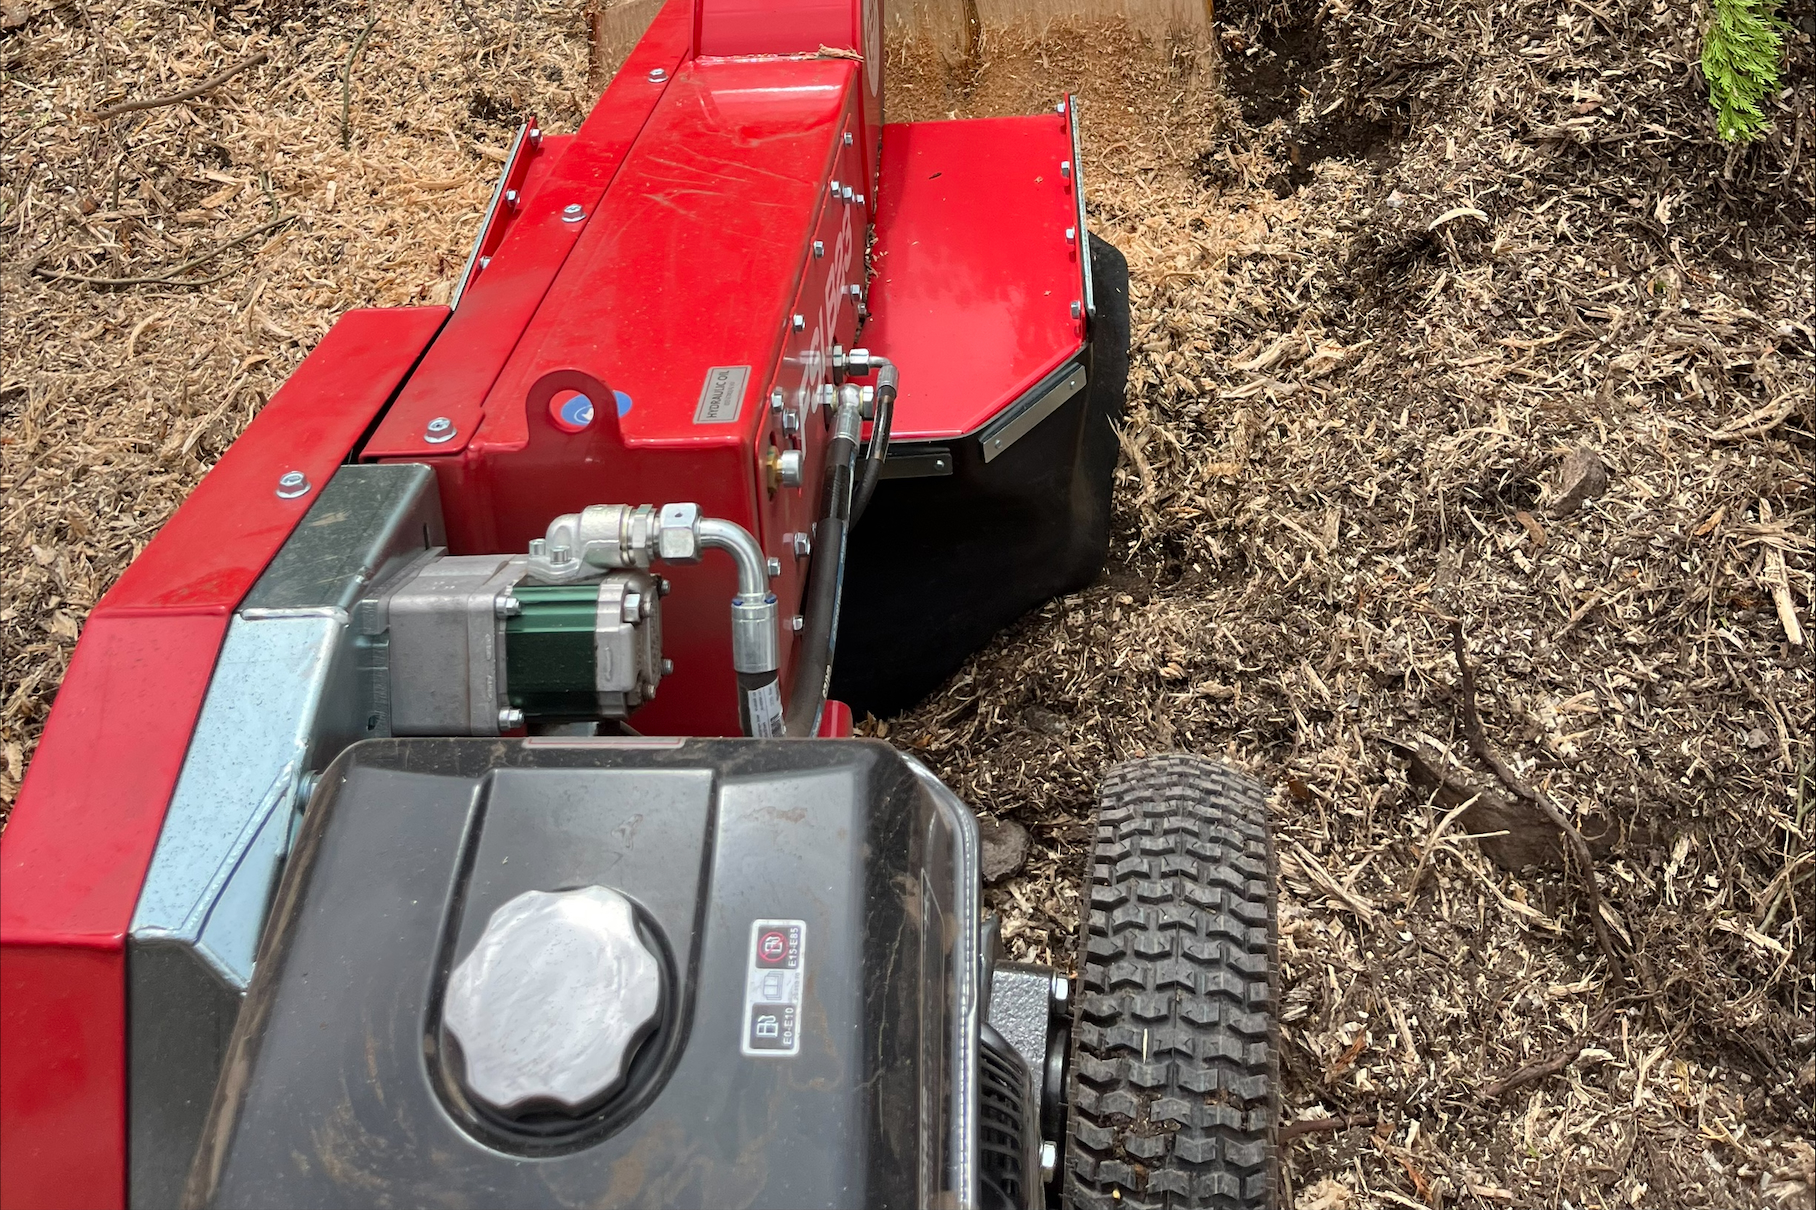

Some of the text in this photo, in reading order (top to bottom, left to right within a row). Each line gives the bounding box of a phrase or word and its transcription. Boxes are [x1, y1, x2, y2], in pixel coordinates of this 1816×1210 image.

[825, 203, 853, 351] B23
[706, 382, 726, 418] HYDRAULIC
[717, 370, 730, 380] OIL
[788, 927, 799, 967] E15-E85
[783, 1007, 794, 1045] E0-E10
